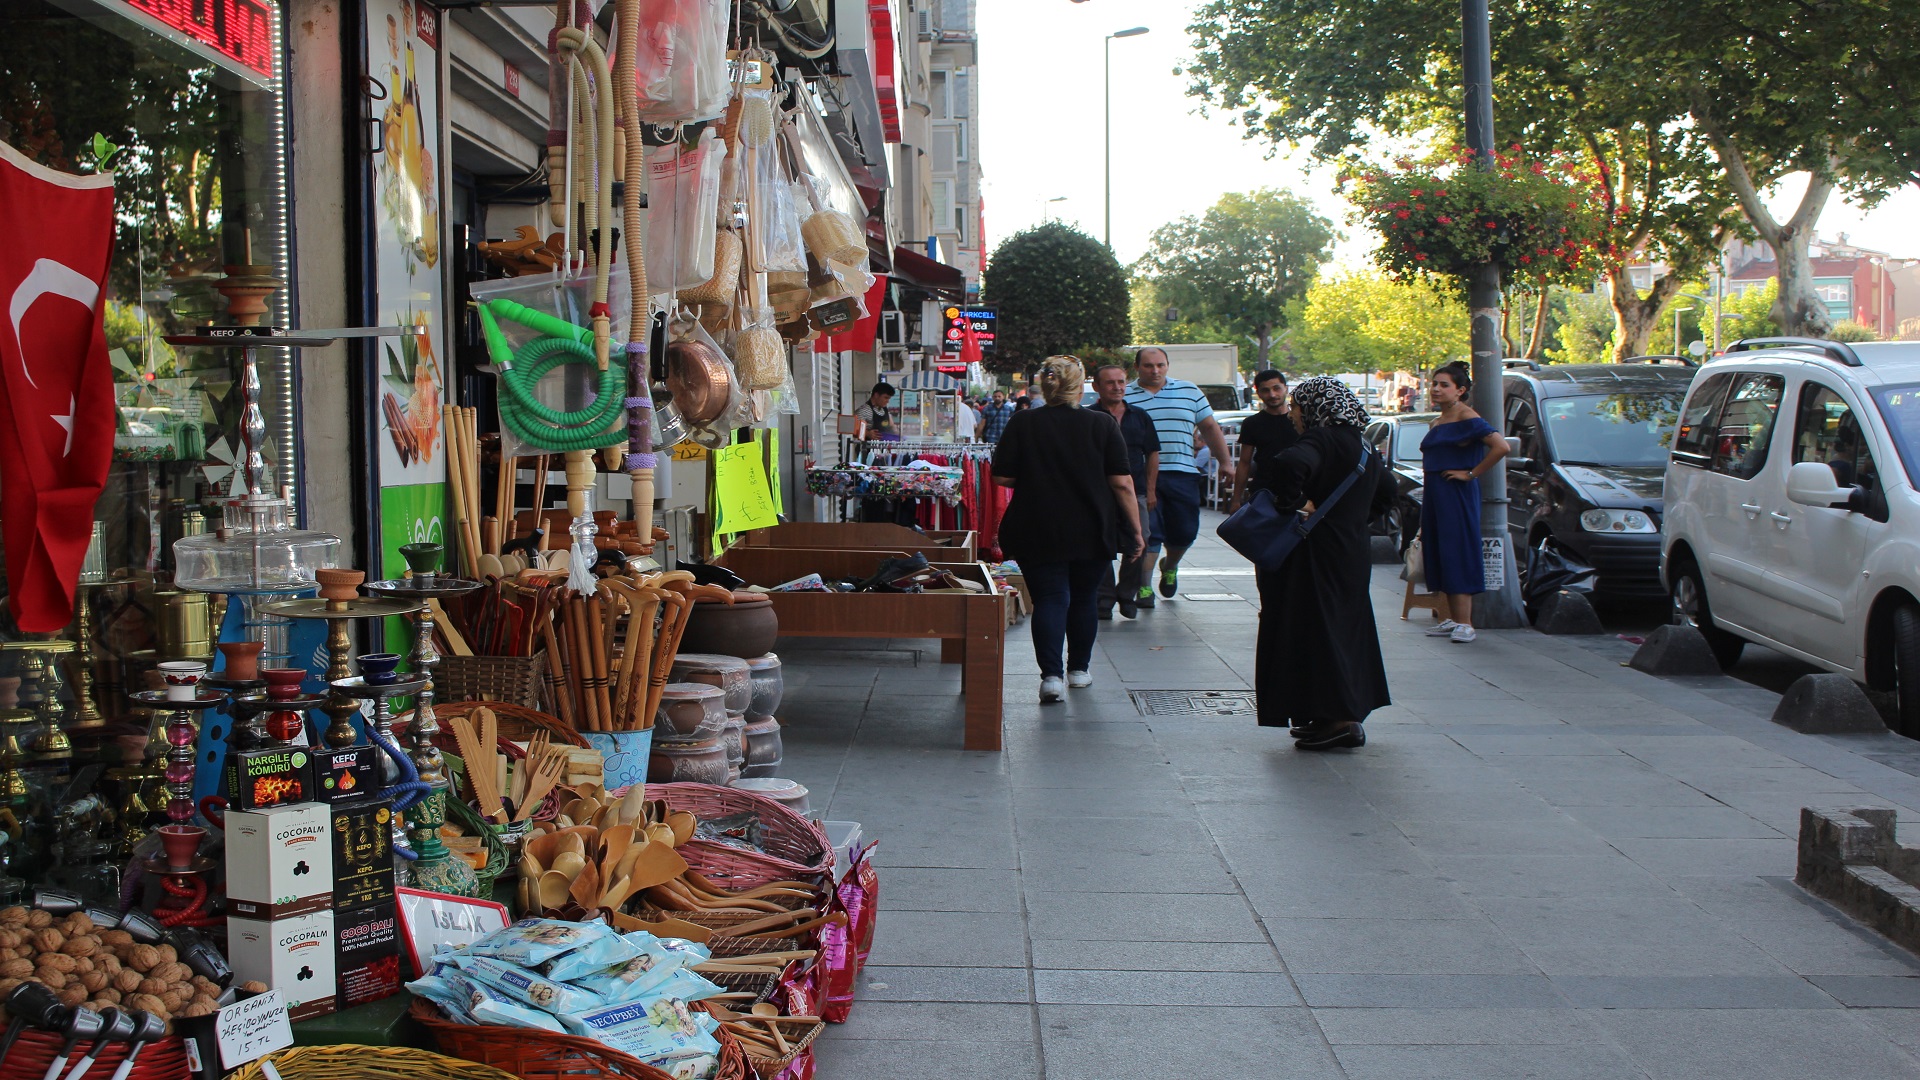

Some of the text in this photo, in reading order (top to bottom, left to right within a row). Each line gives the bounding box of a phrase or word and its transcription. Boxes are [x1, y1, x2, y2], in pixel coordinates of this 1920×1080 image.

[247, 753, 290, 767] NARGİLE
[332, 753, 357, 764] KEFO
[248, 762, 291, 776] KÖMÜRÜ
[276, 826, 325, 841] COCOPALM
[356, 843, 372, 851] KEFO
[341, 918, 394, 939] COCO BALI
[280, 930, 328, 947] COCOPALM
[341, 928, 394, 946] Premium Quality
[356, 939, 375, 949] Natural
[376, 934, 394, 944] Product
[588, 1006, 641, 1028] NECİPBEY
